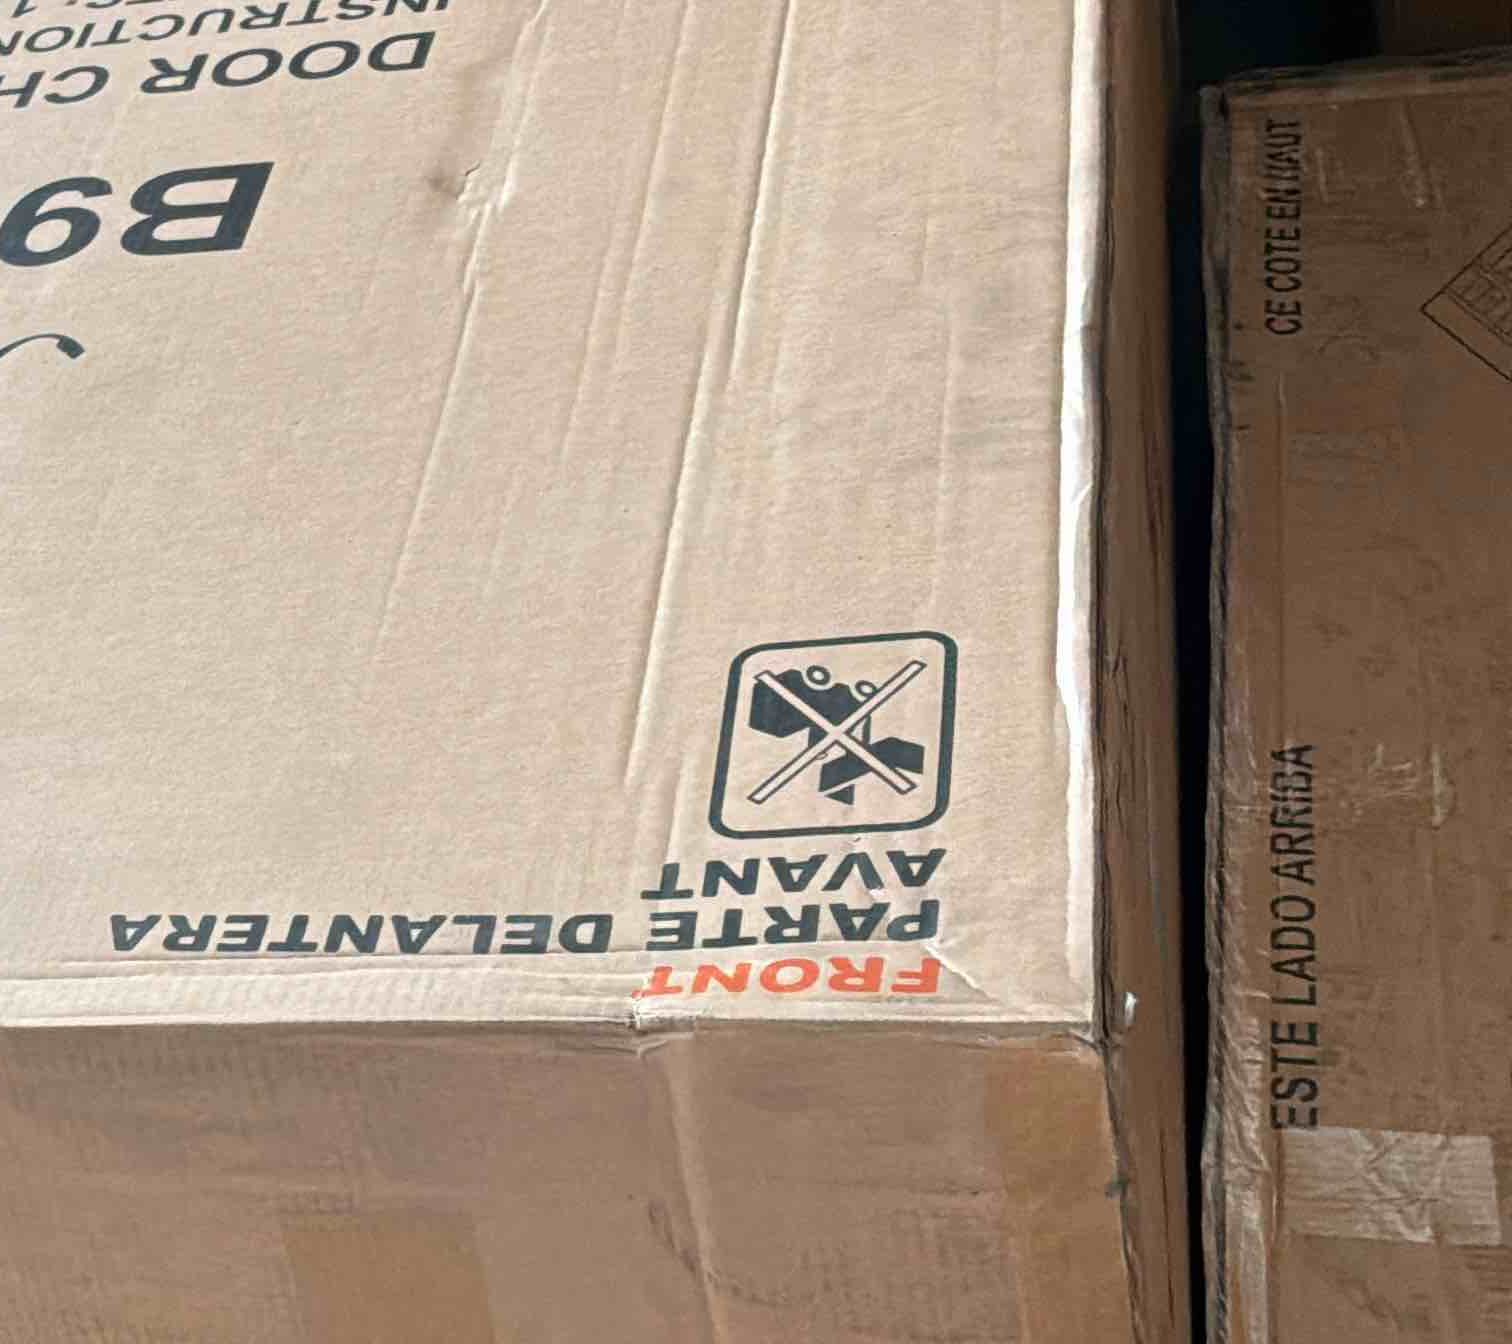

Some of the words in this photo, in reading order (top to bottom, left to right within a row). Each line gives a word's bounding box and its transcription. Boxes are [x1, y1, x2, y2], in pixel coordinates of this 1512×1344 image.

[141, 30, 437, 97] DOOR
[1264, 186, 1303, 221] EN
[1264, 227, 1303, 293] COTE
[1264, 298, 1303, 336] CE
[1270, 744, 1318, 887] ARRIBA
[640, 848, 948, 902] AVANT
[109, 912, 615, 955] DELANTERA
[644, 898, 941, 952] PARTE
[1270, 894, 1317, 1009] LADO
[628, 956, 940, 999] FRONT
[1270, 1020, 1319, 1131] ESTE
